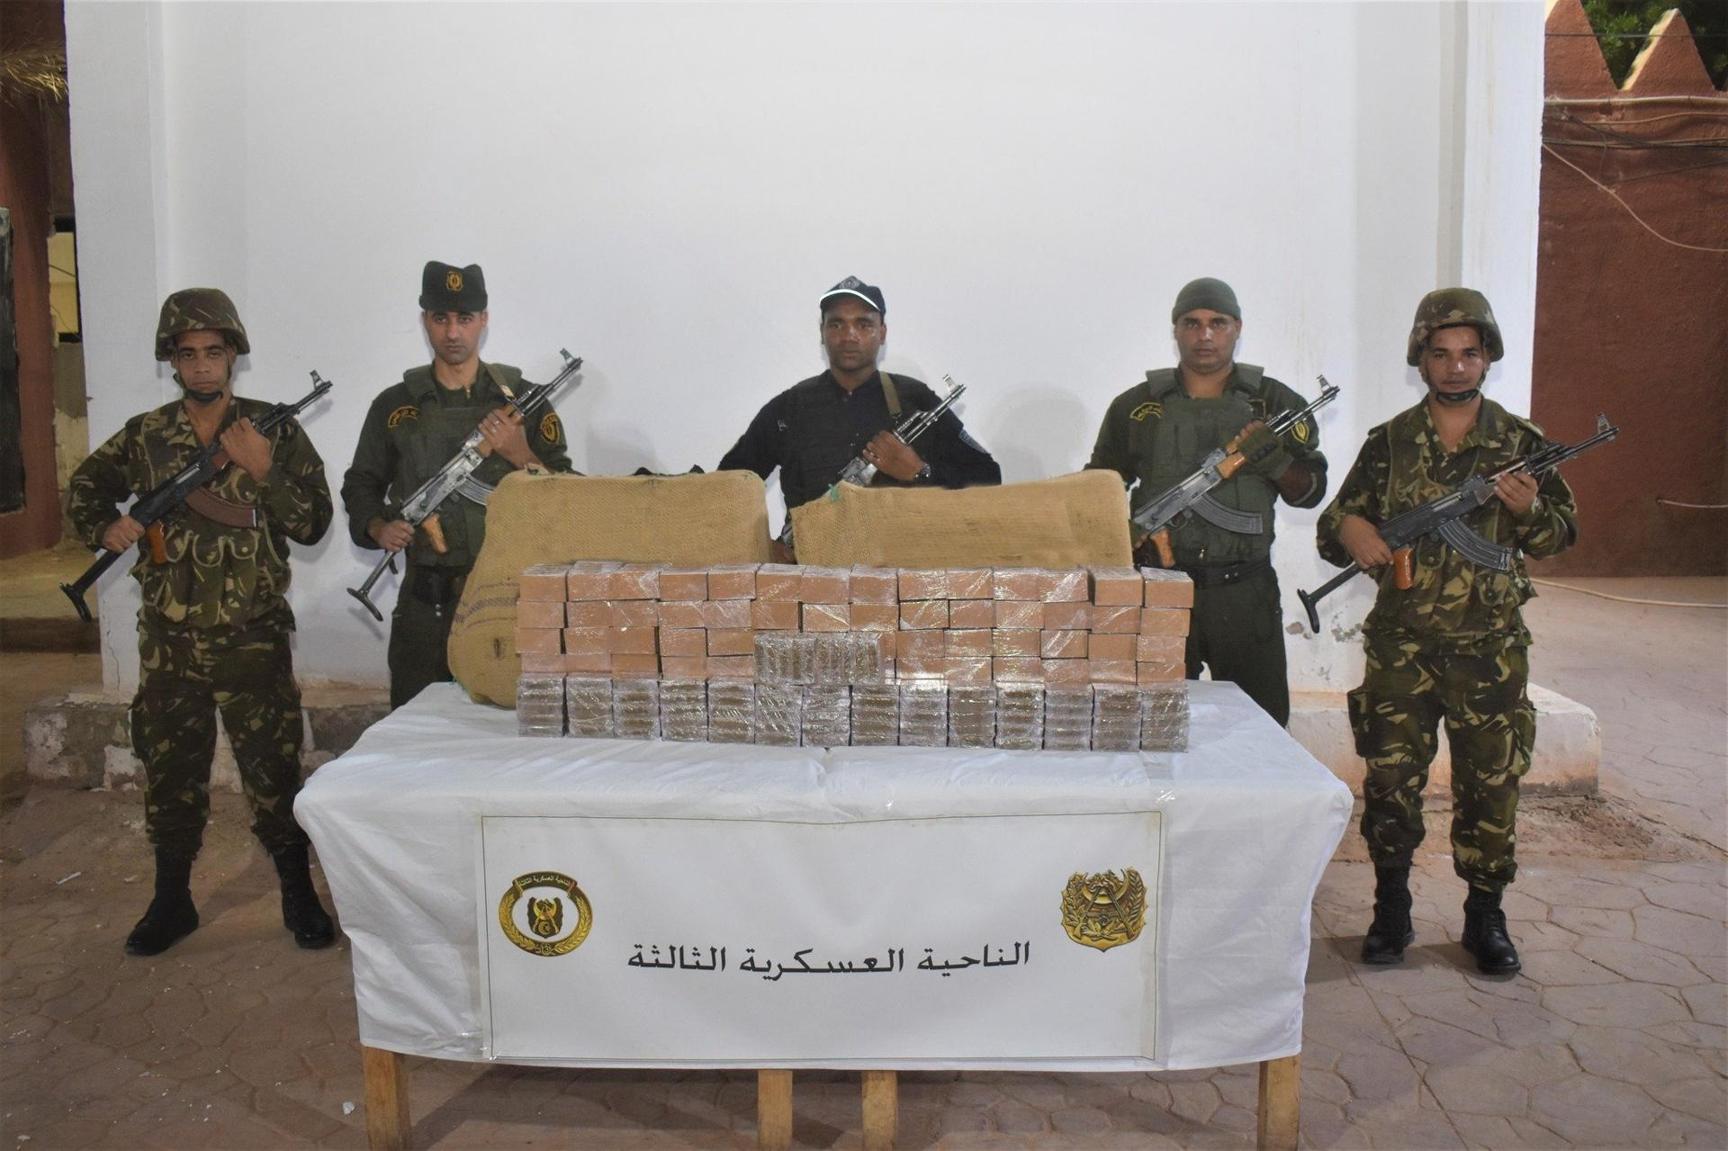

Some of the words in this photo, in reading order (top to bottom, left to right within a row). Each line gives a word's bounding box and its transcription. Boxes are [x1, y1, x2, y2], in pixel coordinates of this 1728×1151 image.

[627, 943, 726, 972] الثالثة
[739, 947, 905, 982] العسكرية
[917, 940, 1030, 977] الناحية
